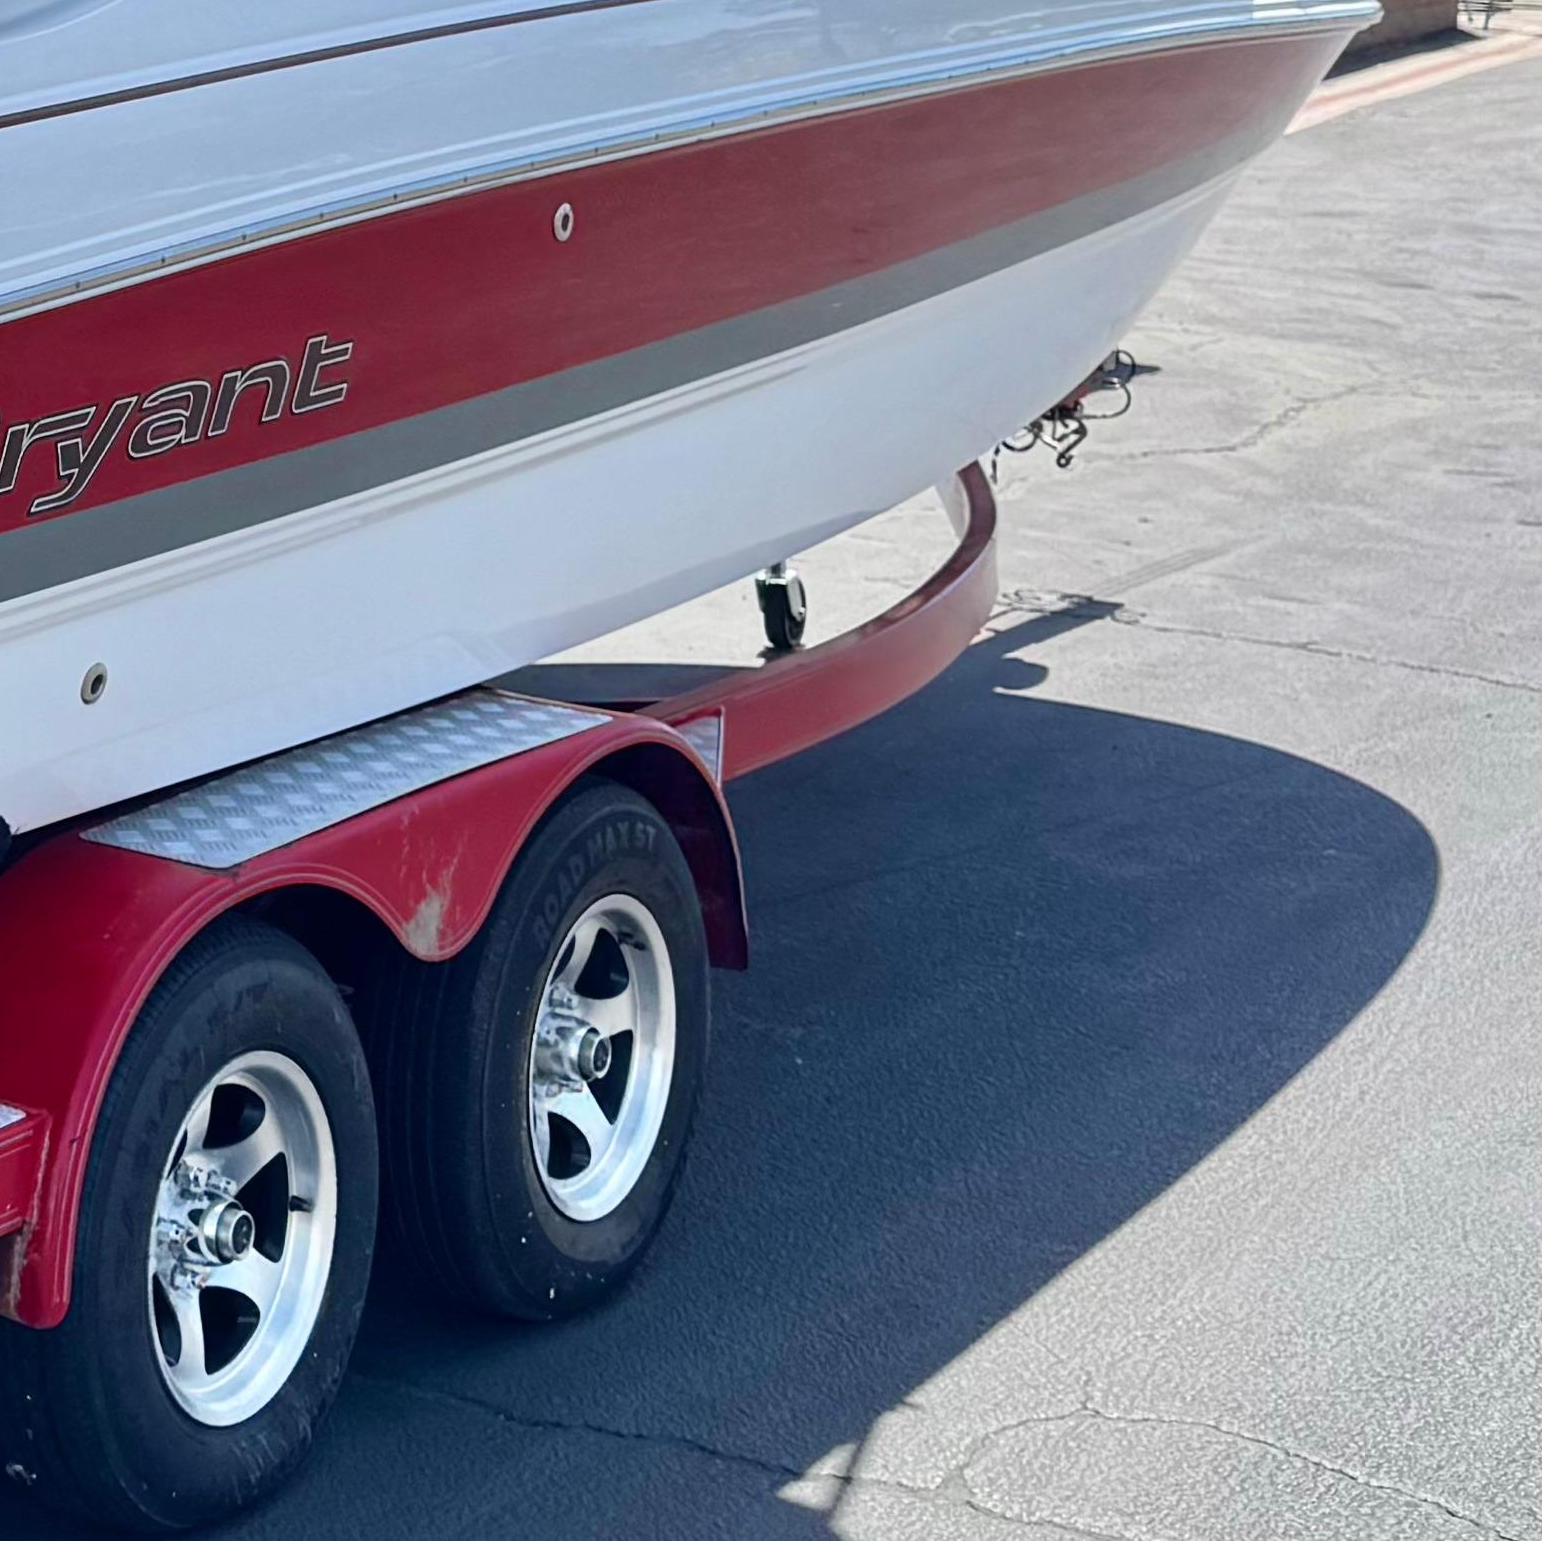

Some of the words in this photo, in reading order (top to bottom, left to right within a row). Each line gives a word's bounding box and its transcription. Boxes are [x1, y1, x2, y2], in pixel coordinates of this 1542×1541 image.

[532, 854, 585, 949] ROAD
[587, 820, 629, 868] MAX
[636, 820, 657, 852] ST
